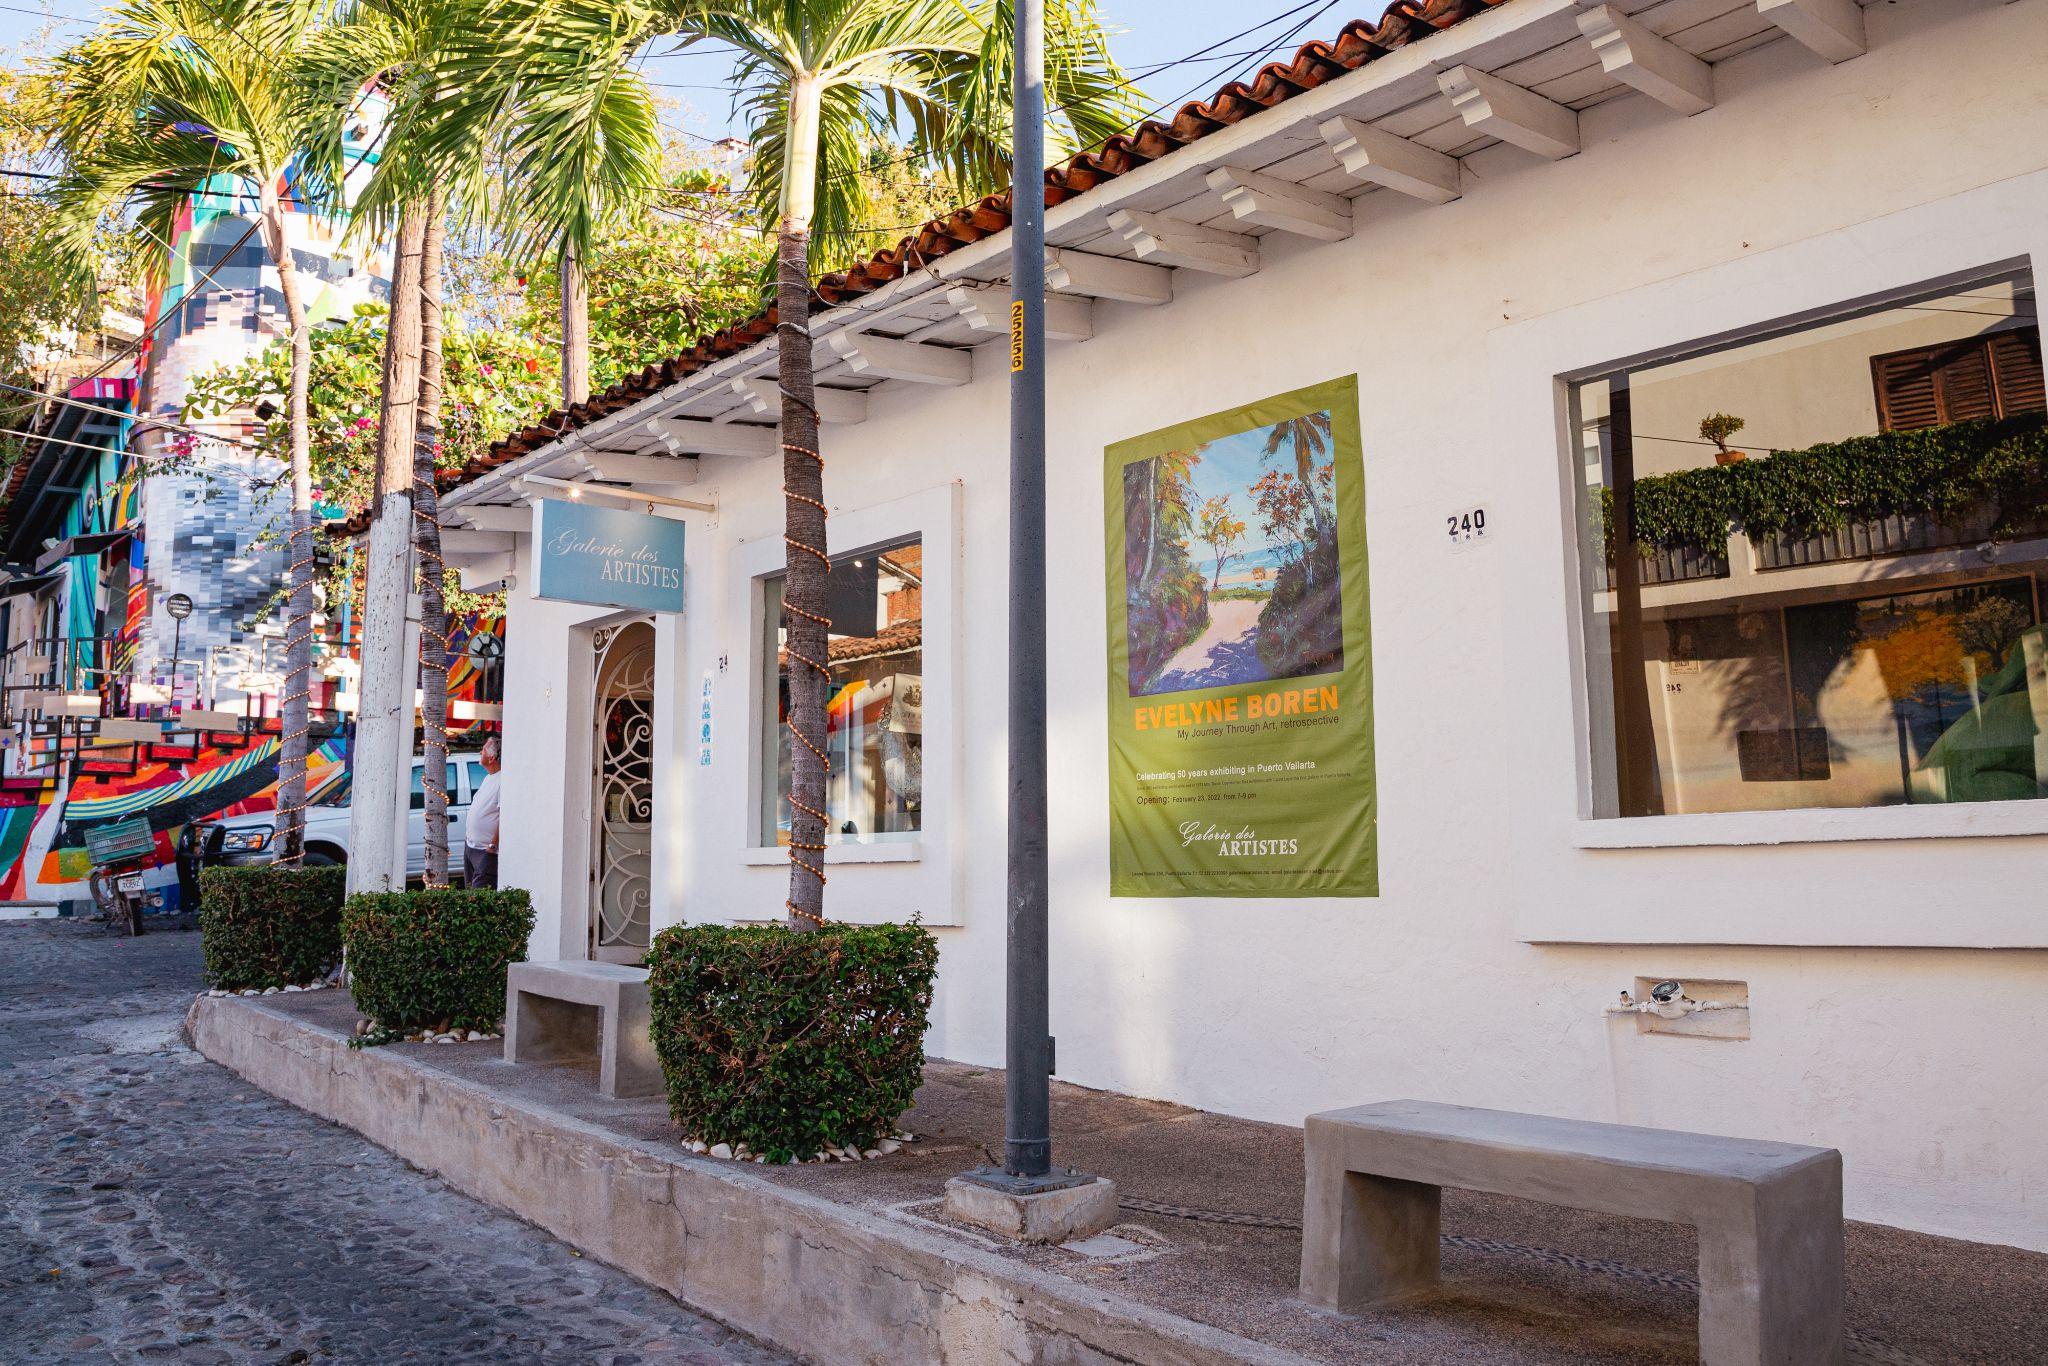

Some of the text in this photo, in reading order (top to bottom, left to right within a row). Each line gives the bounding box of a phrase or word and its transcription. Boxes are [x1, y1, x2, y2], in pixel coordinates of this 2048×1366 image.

[1447, 509, 1485, 536] 240
[547, 526, 660, 563] Galerie des
[601, 559, 679, 589] ARTISTES
[1135, 685, 1340, 731] EVELYNE BOREN
[1177, 714, 1340, 740] My Journey Through Art, retrospective
[1136, 770, 1176, 781] Celebrating
[1177, 769, 1186, 778] 50
[1187, 769, 1208, 779] years
[1209, 765, 1246, 776] exhibiting
[1248, 764, 1255, 773] in
[1257, 762, 1283, 773] Puerto
[1285, 760, 1316, 771] Vallarta
[1136, 795, 1170, 806] Opening:
[1172, 795, 1196, 804] February
[1179, 821, 1255, 848] Galerie des
[1218, 838, 1298, 857] ARTISTES
